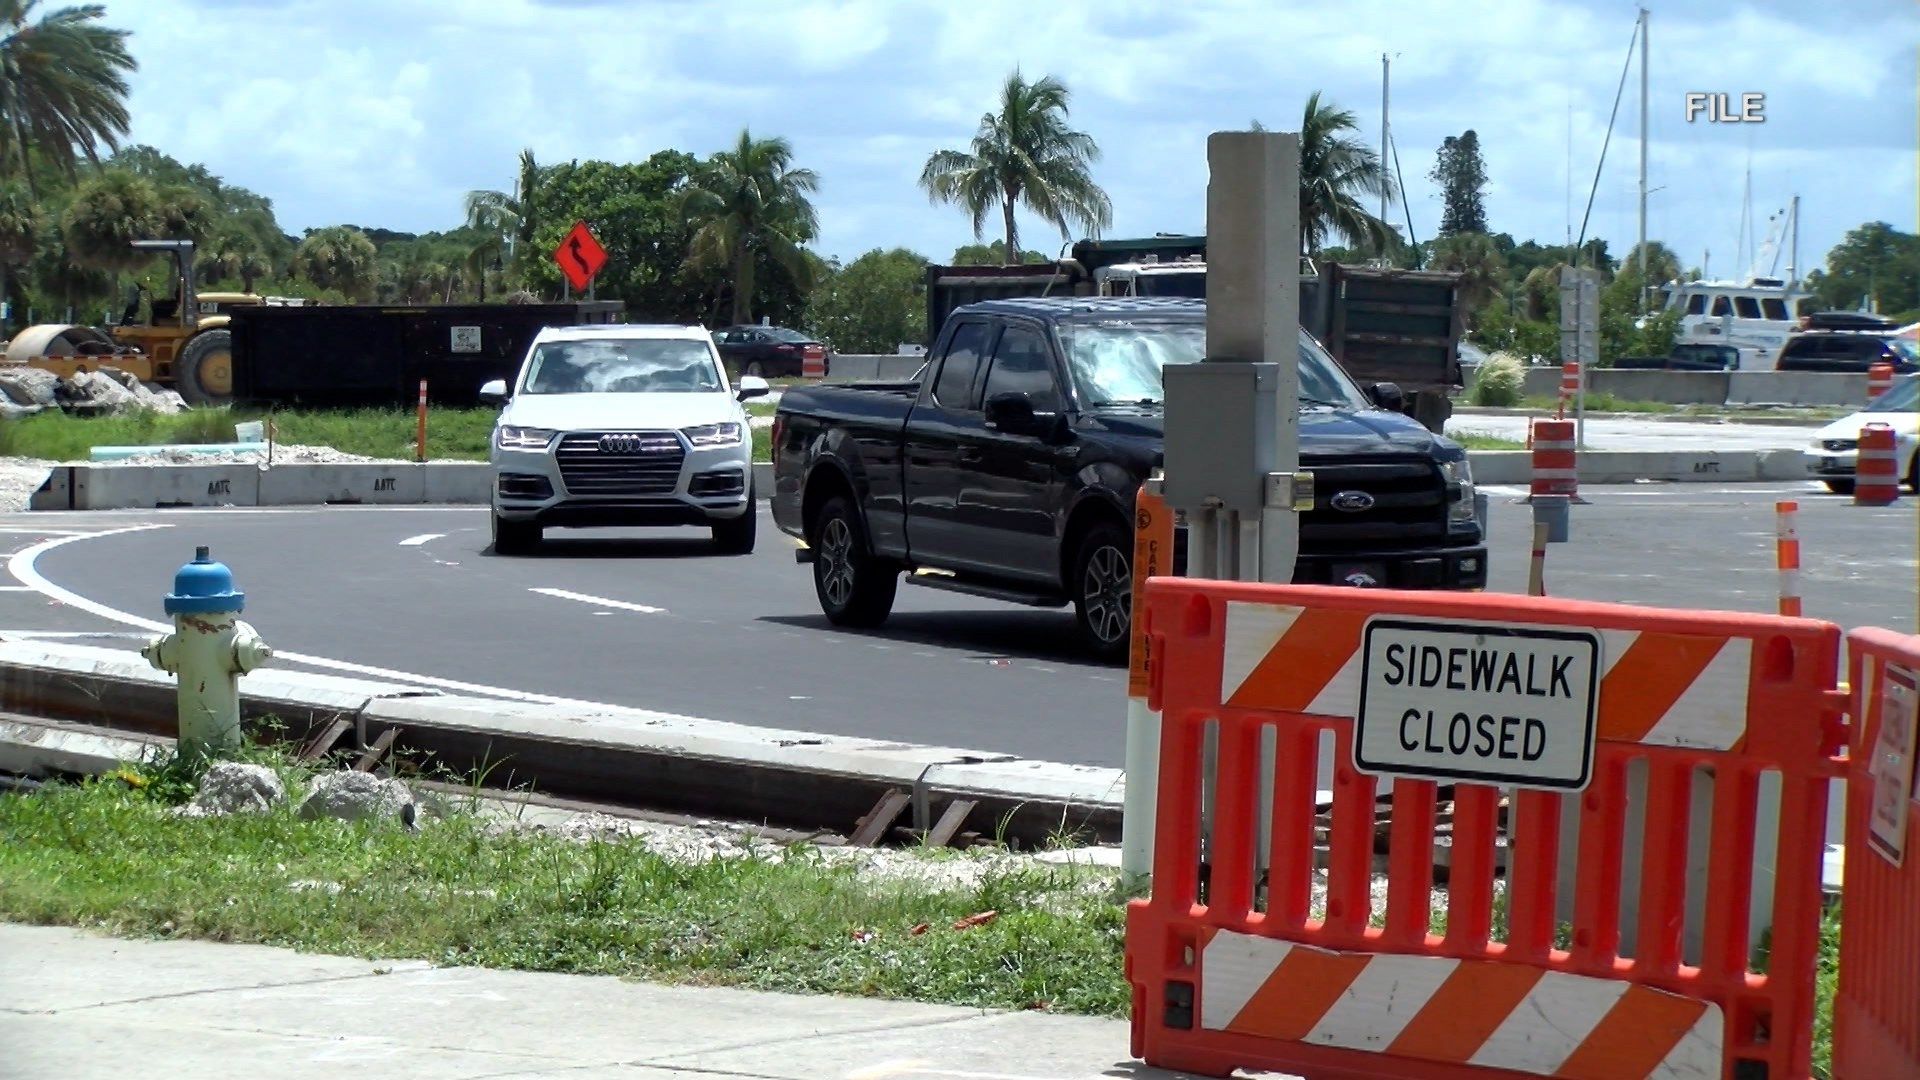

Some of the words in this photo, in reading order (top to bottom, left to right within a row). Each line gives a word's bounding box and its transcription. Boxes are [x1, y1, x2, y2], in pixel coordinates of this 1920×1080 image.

[374, 478, 396, 491] AATC
[1383, 643, 1574, 698] SIDEWALK
[1400, 708, 1546, 761] CLOSED
